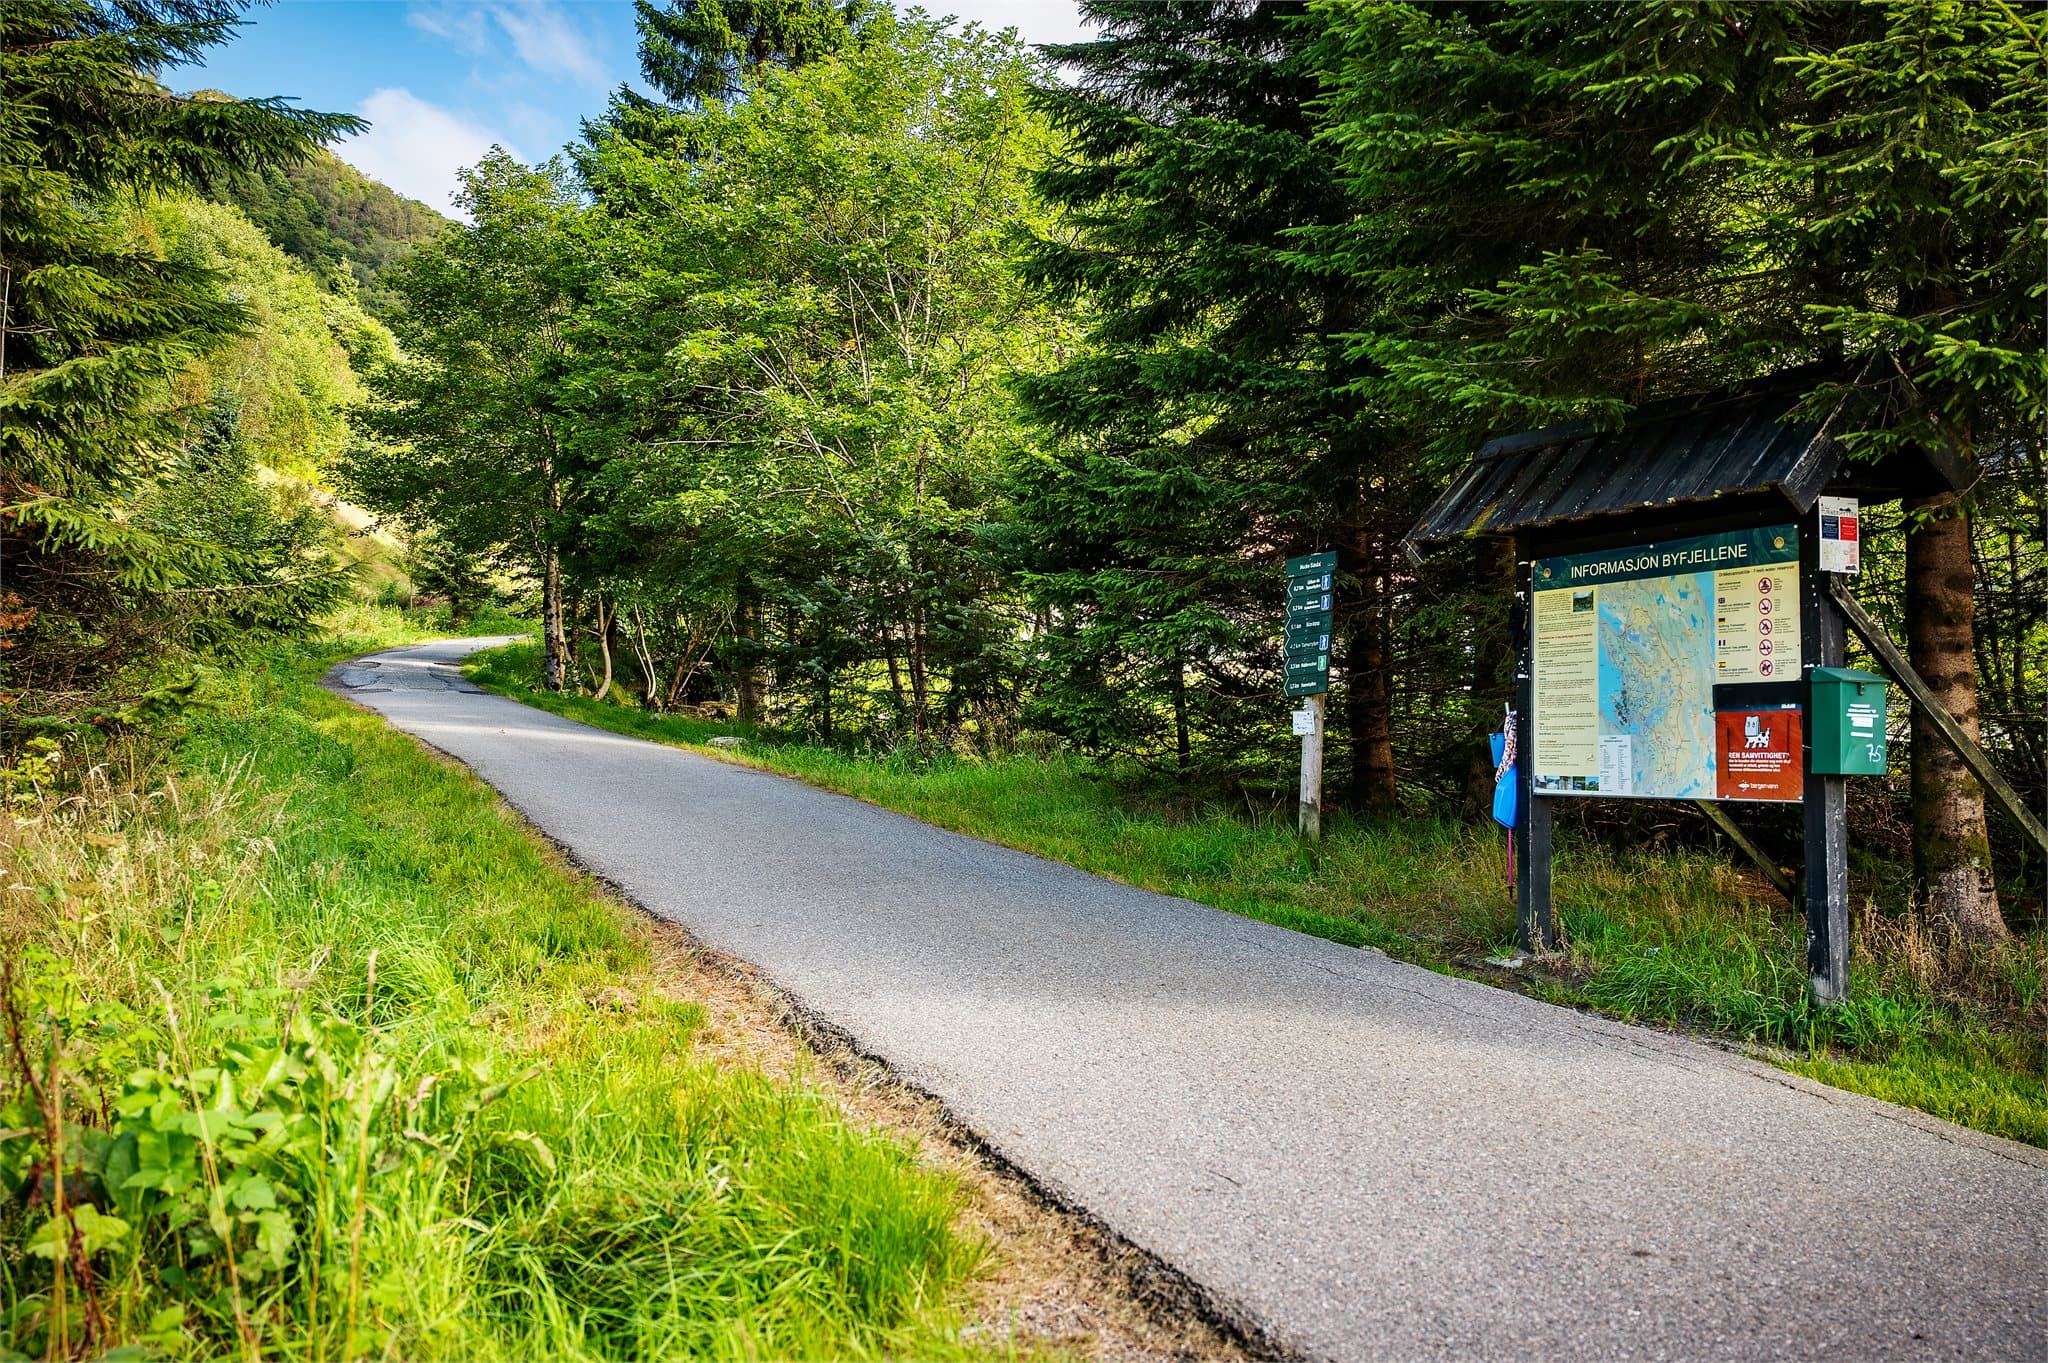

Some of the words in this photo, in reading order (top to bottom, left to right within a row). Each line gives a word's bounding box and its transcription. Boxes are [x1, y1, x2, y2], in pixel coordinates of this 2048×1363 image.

[1571, 555, 1659, 579] INFORMASJON
[1662, 543, 1748, 567] BYFJELLENE
[1865, 743, 1884, 762] 75
